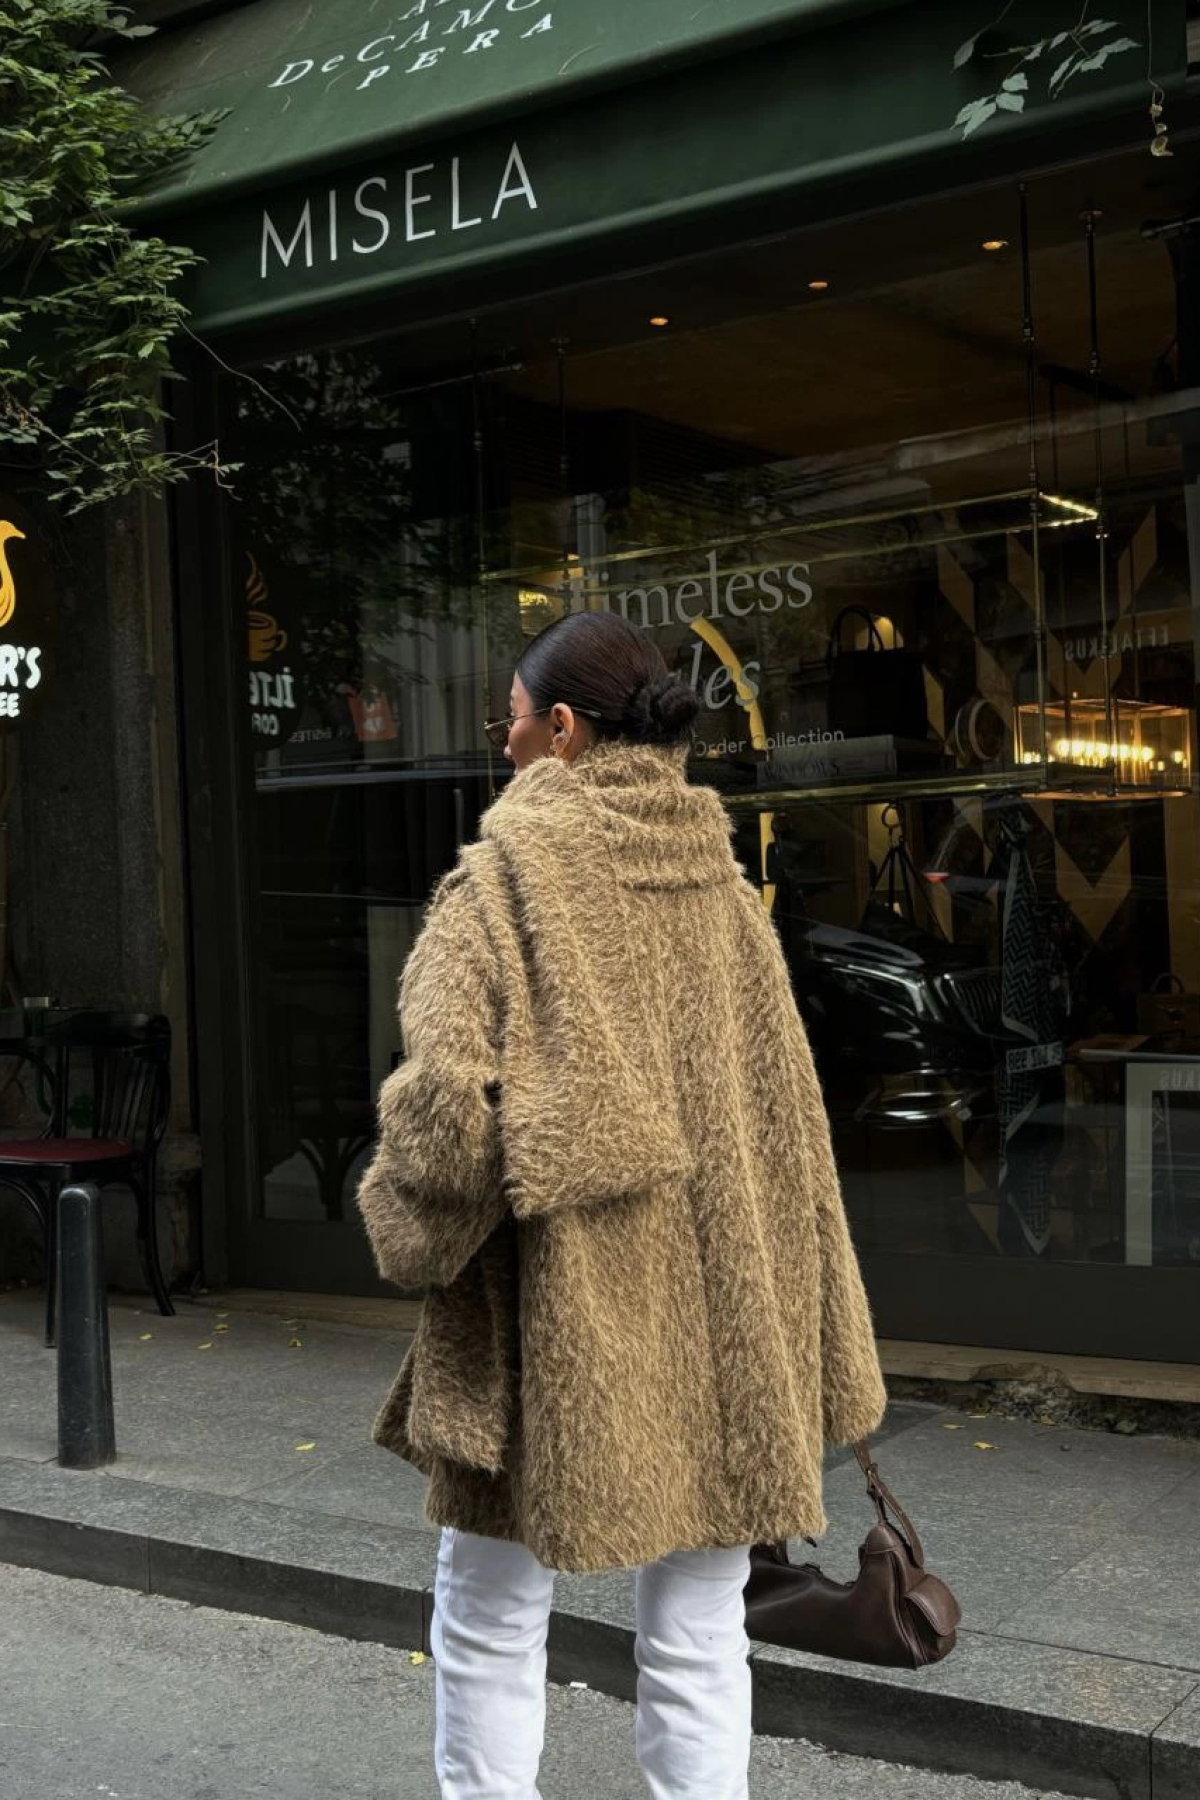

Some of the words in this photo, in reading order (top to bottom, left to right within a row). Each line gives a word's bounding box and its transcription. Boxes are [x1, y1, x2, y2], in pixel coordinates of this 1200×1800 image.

[268, 0, 541, 88] DeCAM
[356, 13, 554, 91] PERA
[260, 141, 538, 279] MISELA
[0, 644, 42, 690] R'S
[667, 641, 761, 710] les
[694, 737, 747, 757] Order
